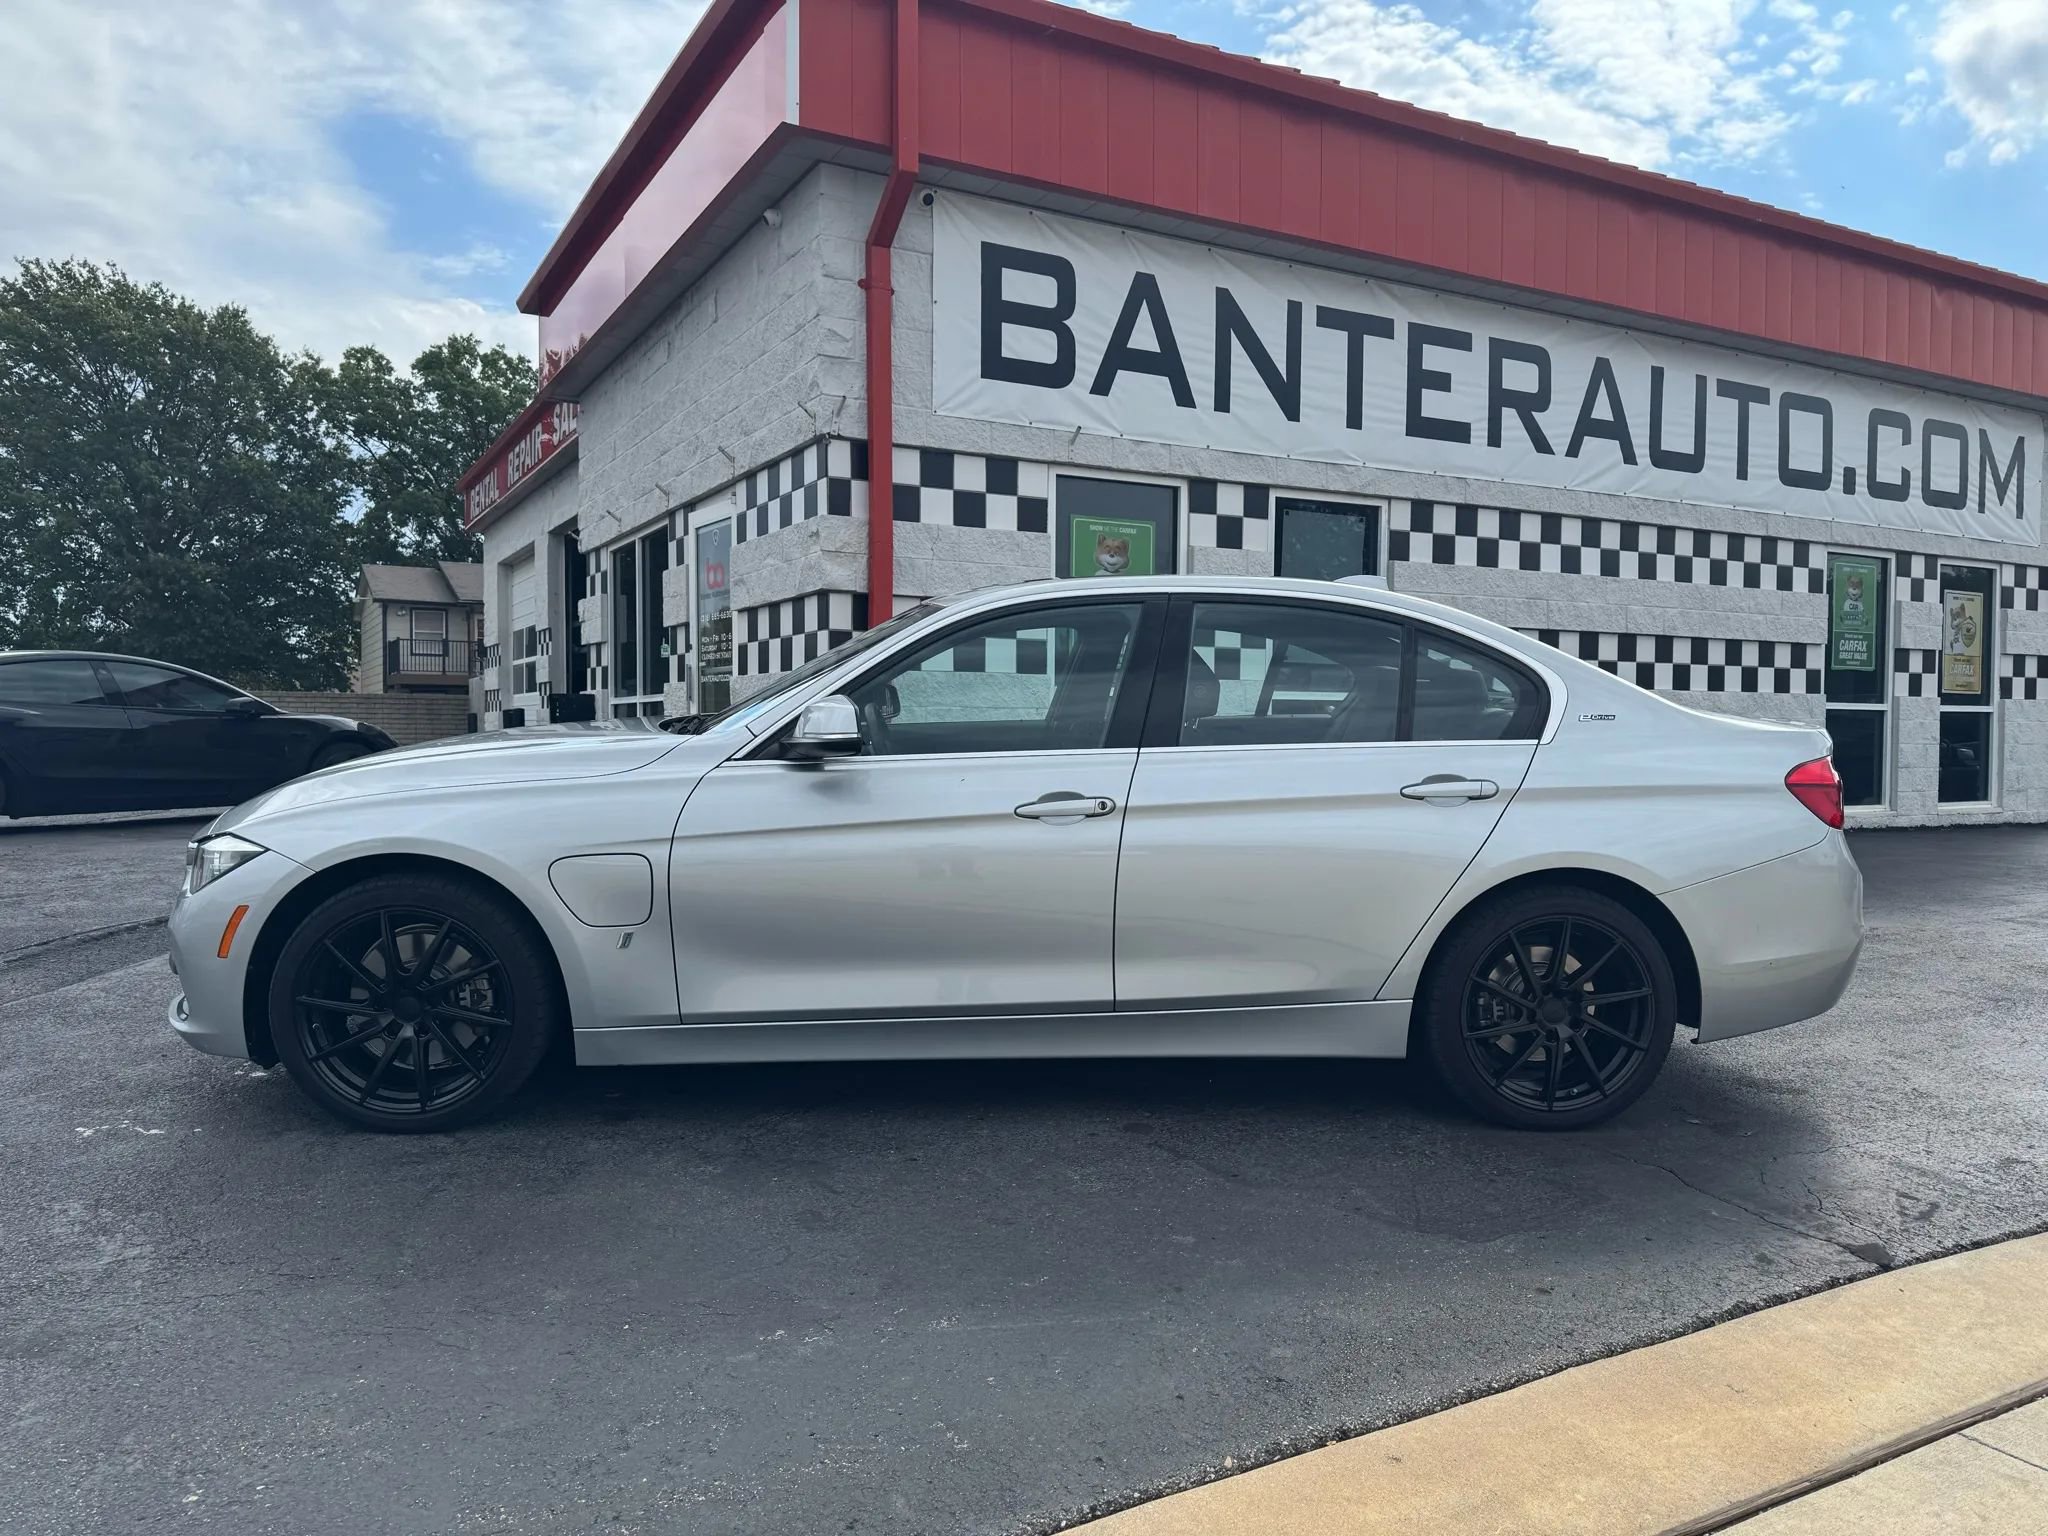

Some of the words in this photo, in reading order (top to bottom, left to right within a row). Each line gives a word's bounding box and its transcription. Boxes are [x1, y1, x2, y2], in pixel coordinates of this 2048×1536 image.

[980, 240, 2027, 520] BANTERAUTO.COM
[470, 467, 499, 520] RENTAL
[507, 422, 542, 488] REPAIR
[553, 402, 579, 446] SAL
[1839, 639, 1868, 652] CARFAX
